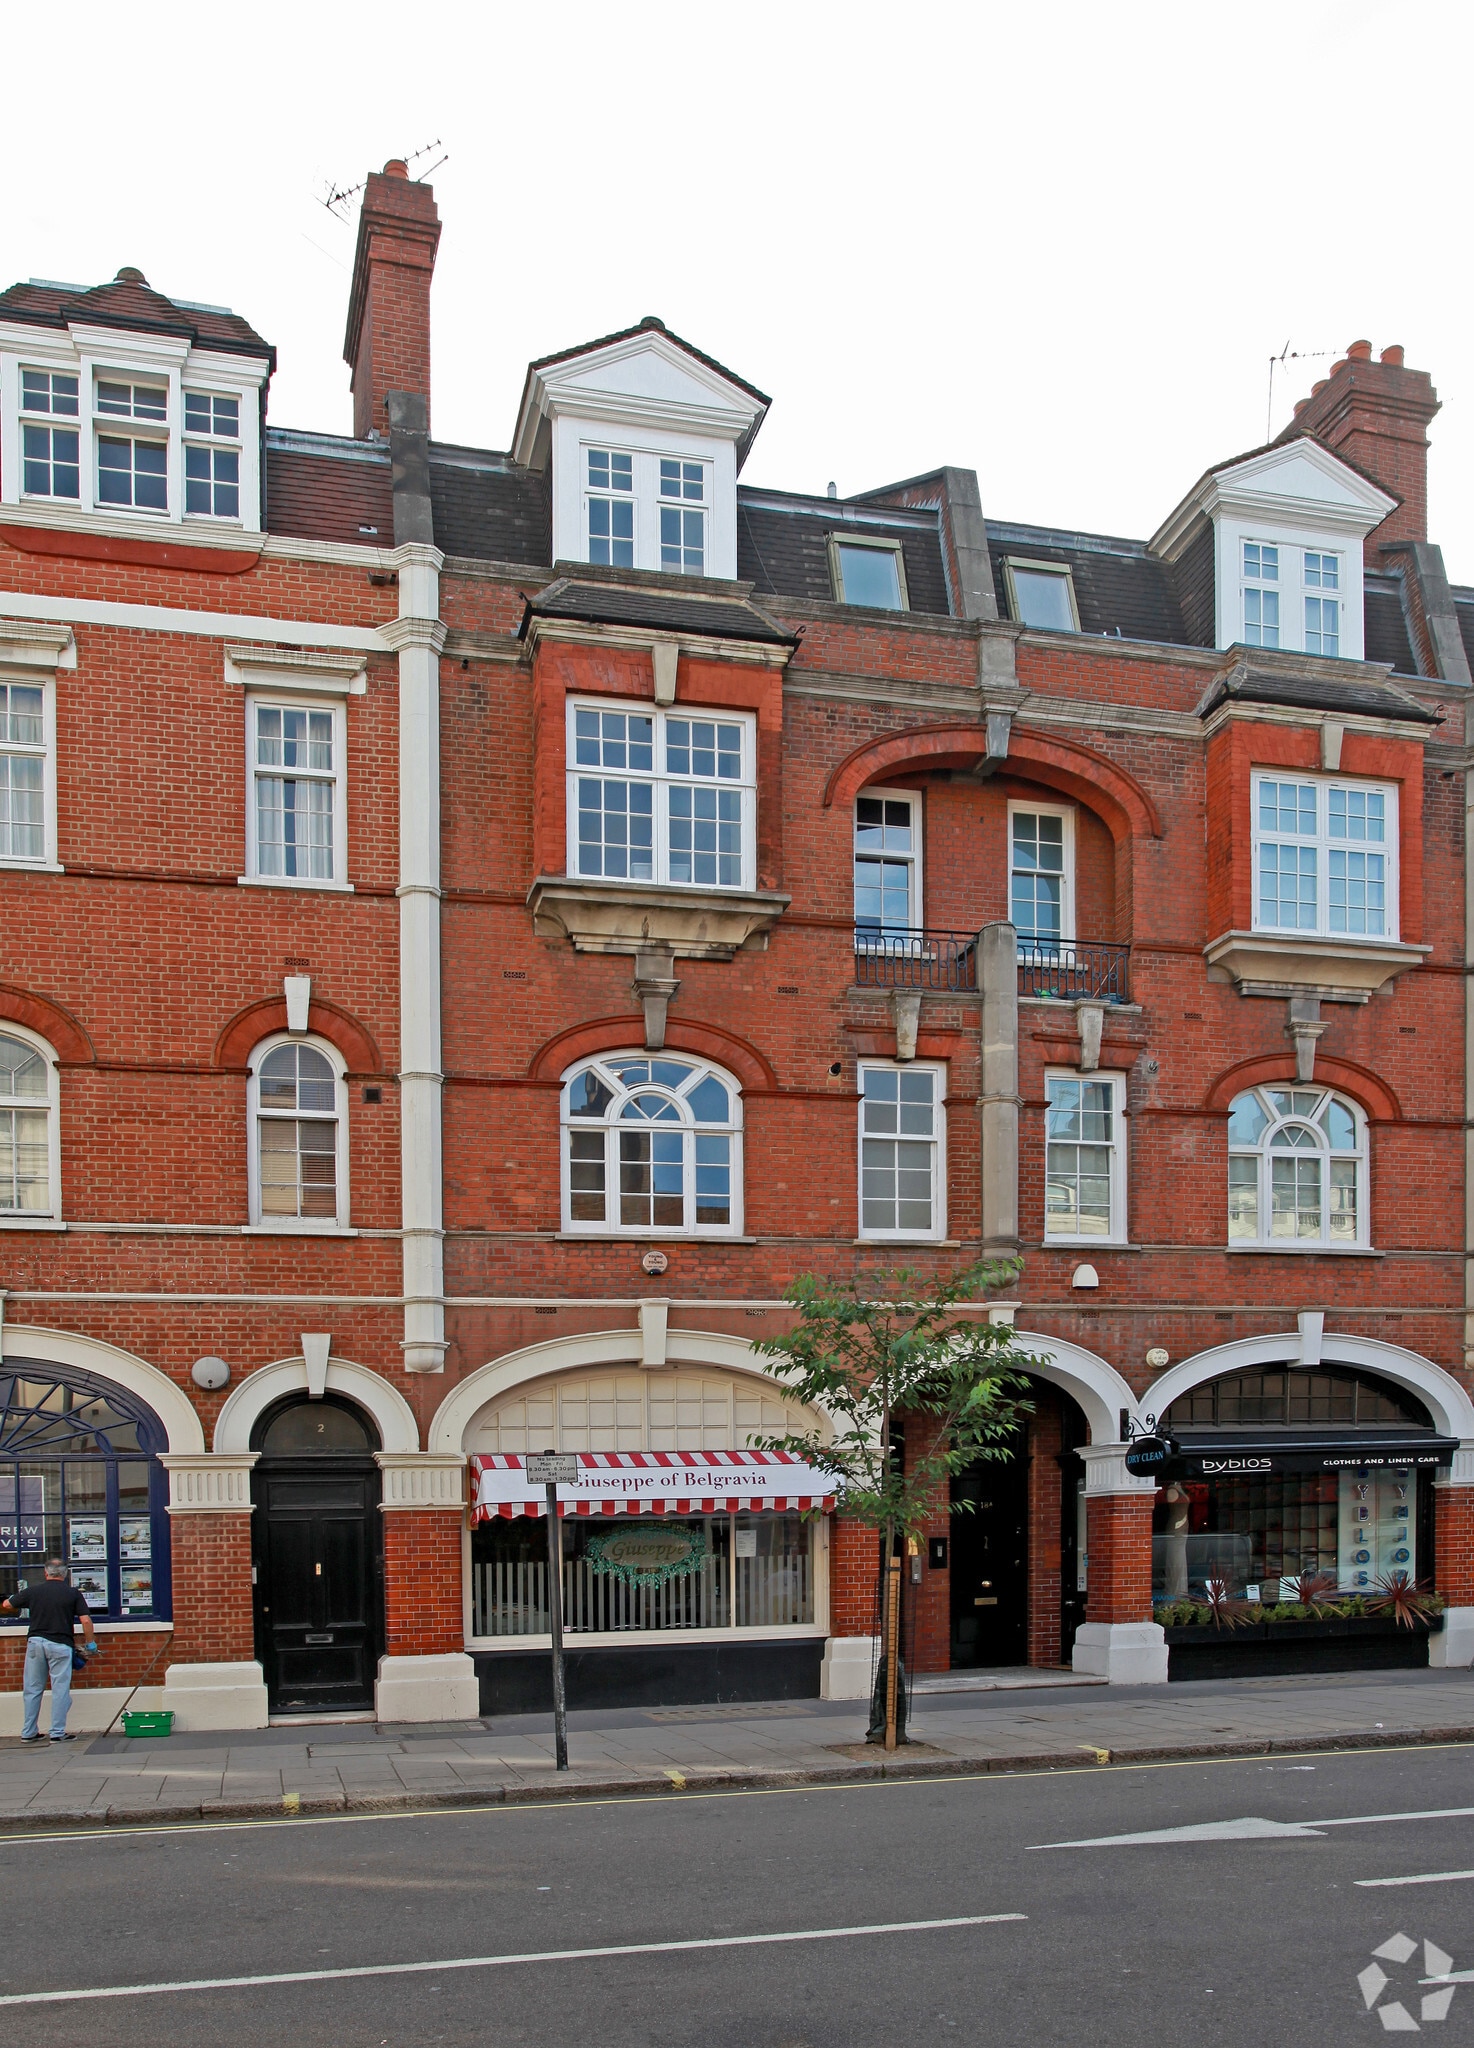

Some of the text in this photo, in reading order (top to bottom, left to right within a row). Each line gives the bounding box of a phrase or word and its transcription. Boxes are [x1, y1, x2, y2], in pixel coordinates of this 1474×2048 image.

[317, 1423, 325, 1433] 2
[1127, 1450, 1164, 1465] DRY CLEAN
[660, 1473, 679, 1486] of
[685, 1471, 767, 1490] Belgravia
[612, 1541, 685, 1561] Giuseppe
